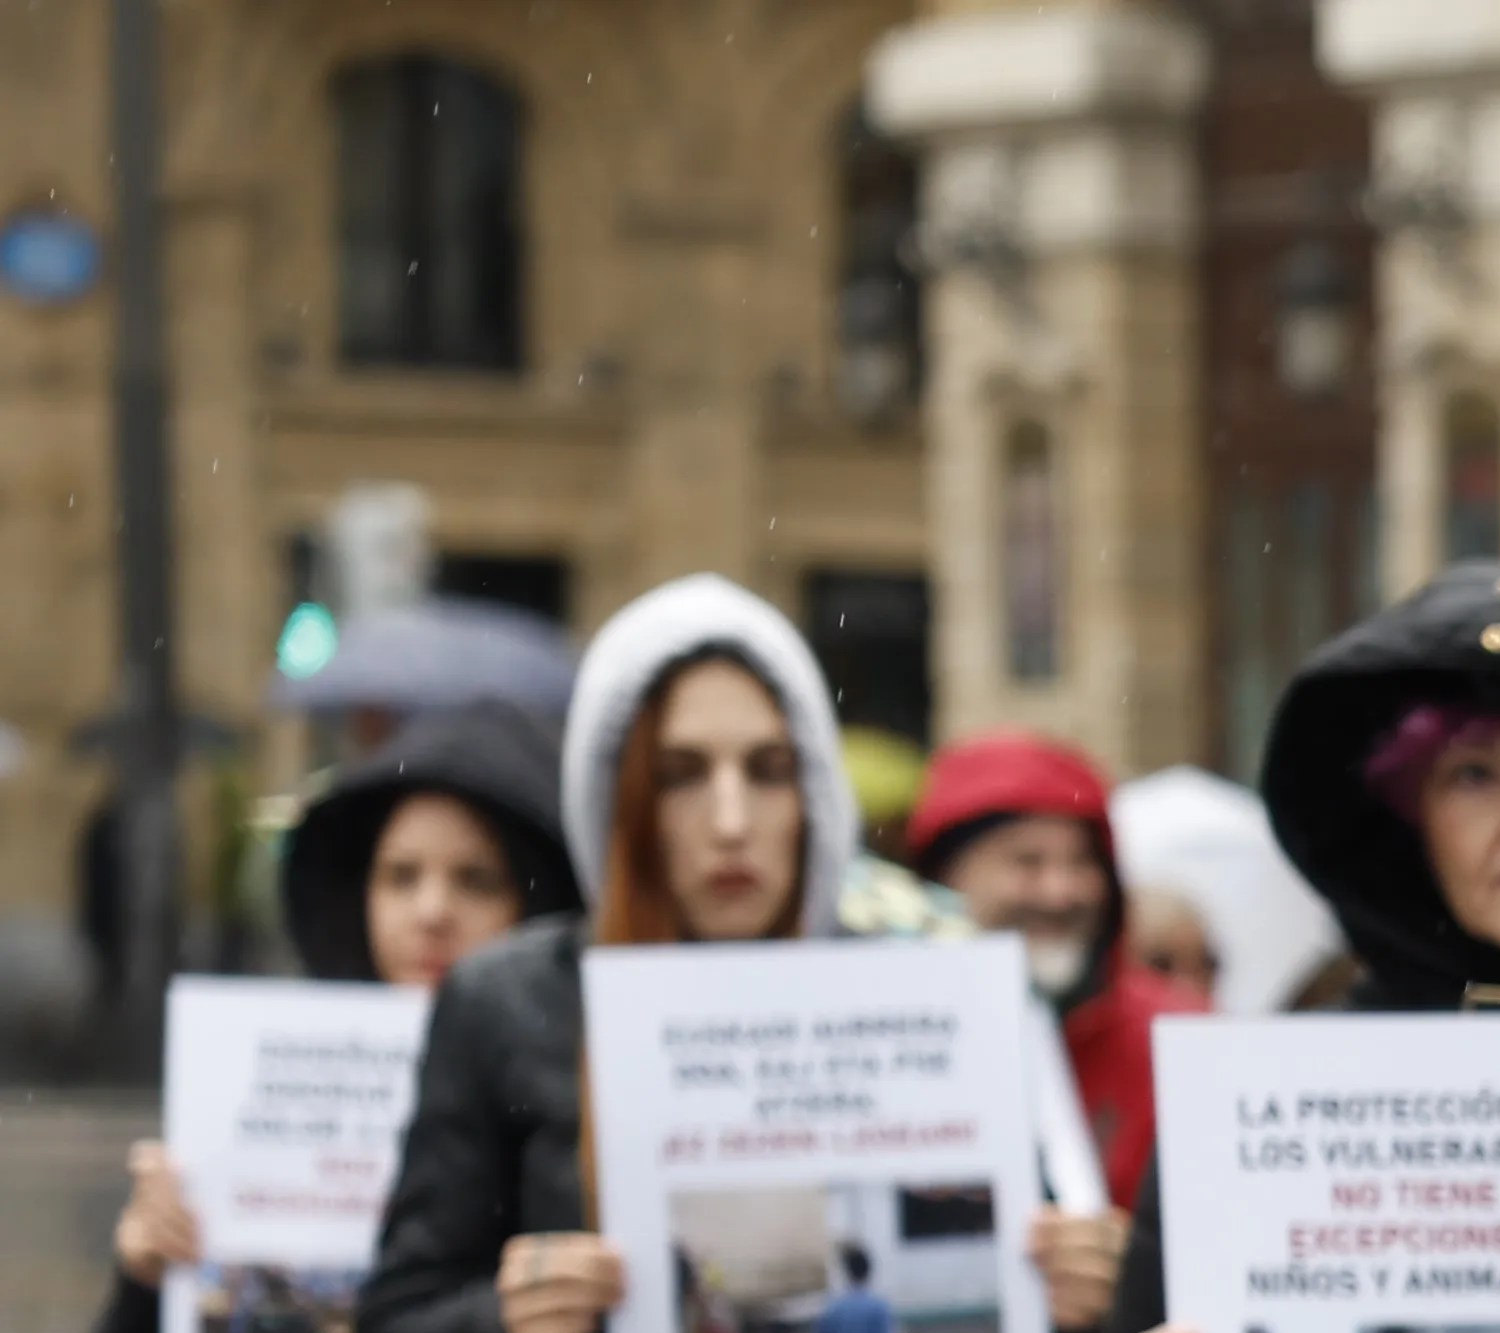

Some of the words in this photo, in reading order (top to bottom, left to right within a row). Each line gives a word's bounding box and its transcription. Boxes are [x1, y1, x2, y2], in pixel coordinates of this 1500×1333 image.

[1238, 1095, 1284, 1126] LA
[1239, 1137, 1308, 1169] LOS
[1332, 1182, 1381, 1210] NO
[1397, 1180, 1496, 1208] TIENE
[1248, 1258, 1359, 1298] NIÑOS
[1371, 1265, 1391, 1297] Y
